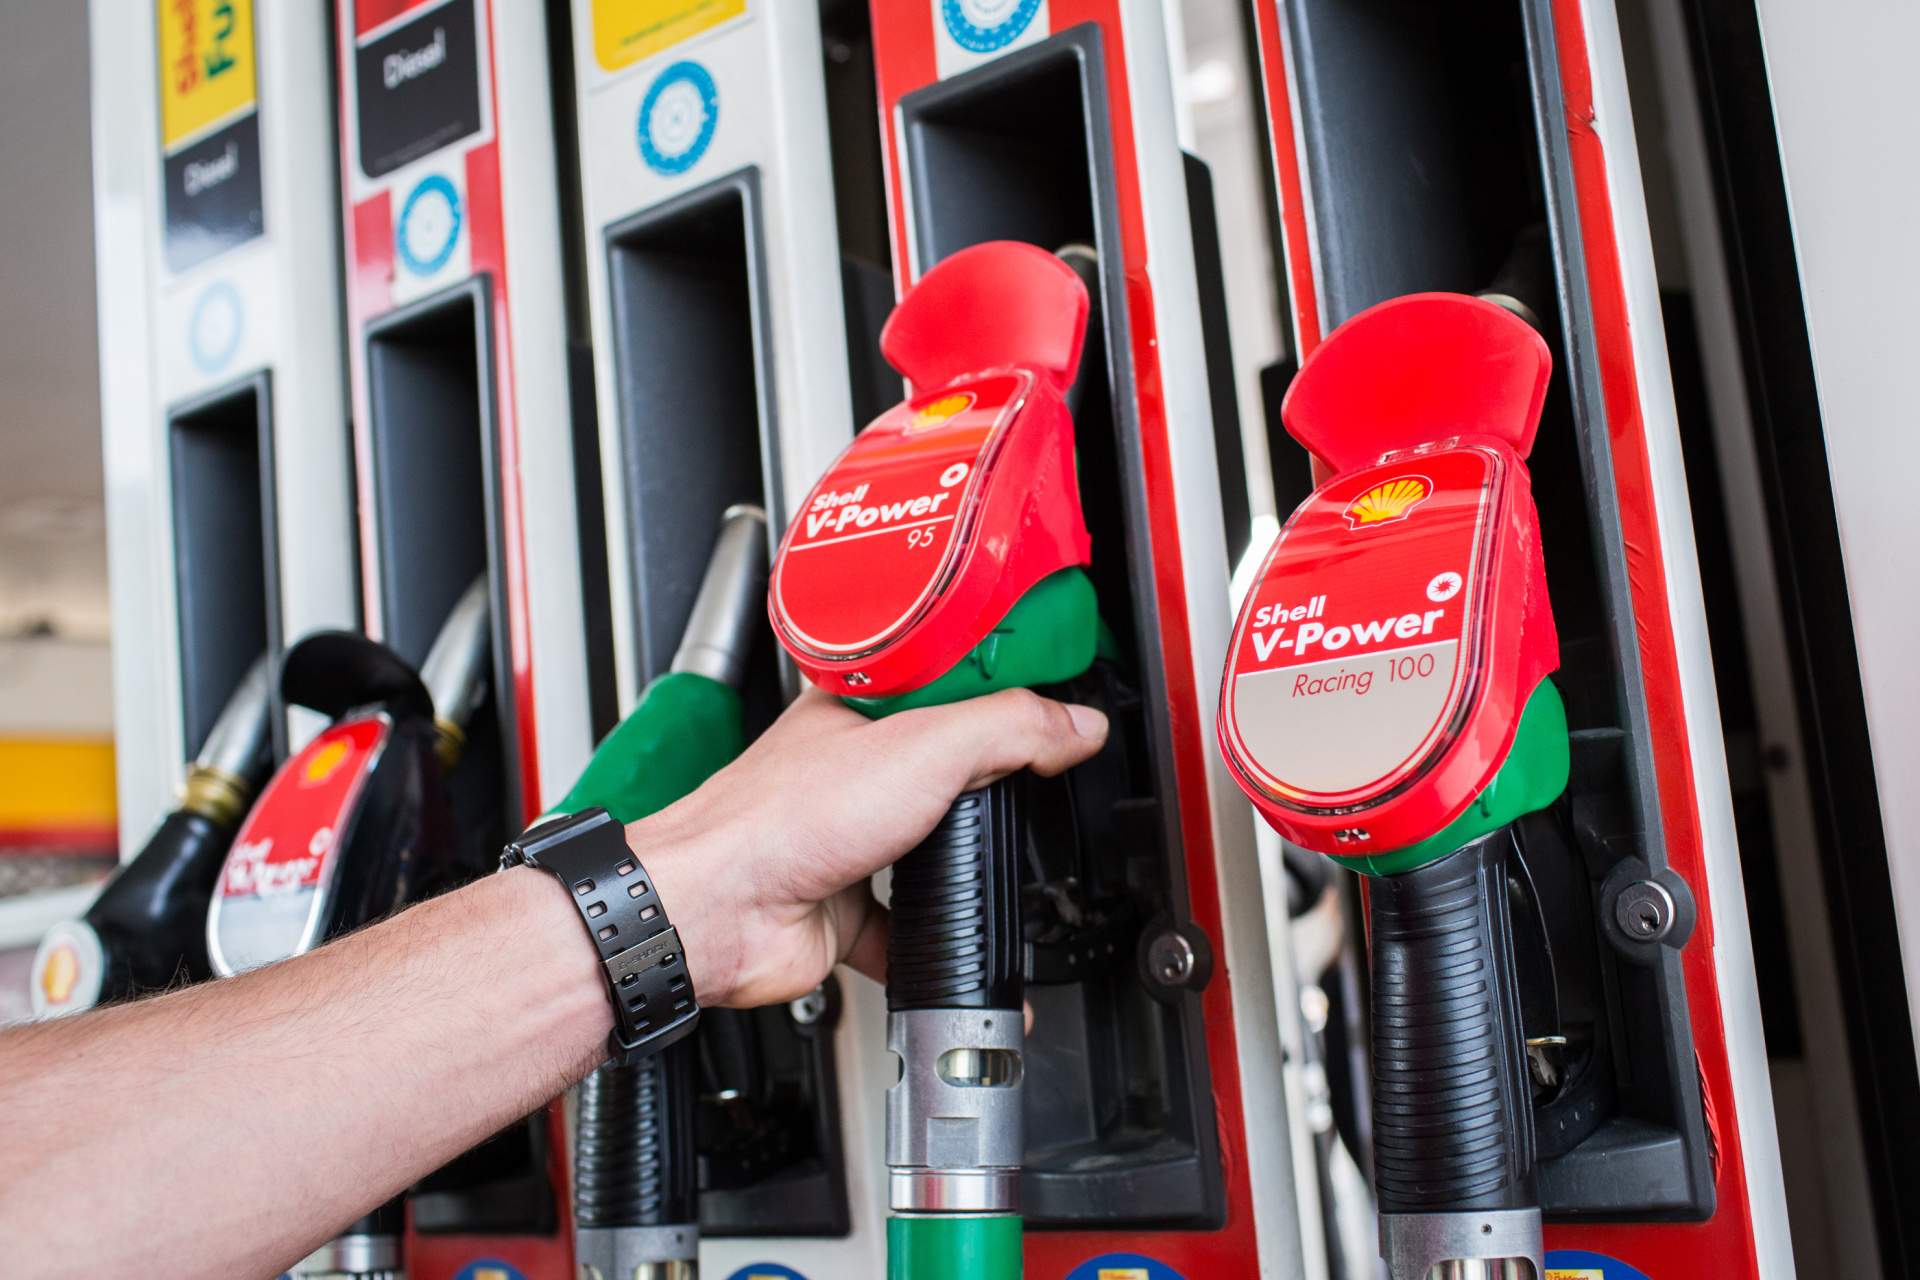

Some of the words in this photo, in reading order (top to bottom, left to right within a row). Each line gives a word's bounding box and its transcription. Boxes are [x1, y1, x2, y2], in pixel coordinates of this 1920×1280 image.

[806, 492, 949, 538] V-Power
[811, 484, 870, 512] Shell
[907, 526, 936, 550] 95
[1253, 595, 1327, 628] Shell
[1252, 609, 1444, 663] V-Power
[1292, 668, 1373, 698] Racing
[1389, 653, 1434, 682] 100
